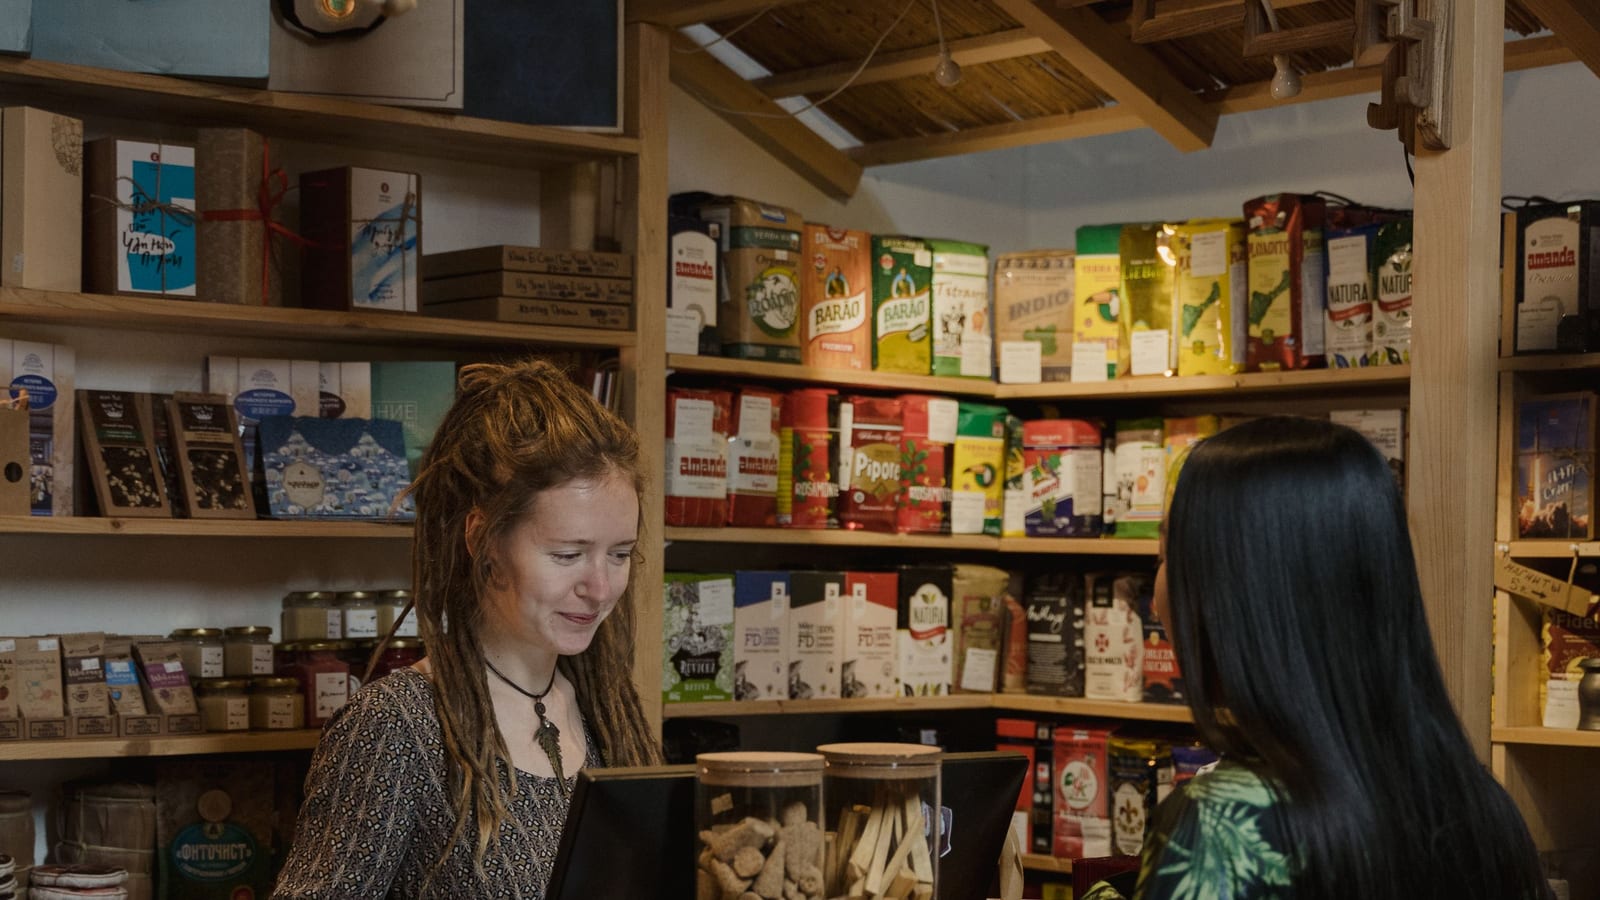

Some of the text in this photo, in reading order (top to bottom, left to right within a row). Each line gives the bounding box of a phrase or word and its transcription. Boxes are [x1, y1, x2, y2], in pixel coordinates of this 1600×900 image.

[1528, 246, 1576, 270] amanda
[676, 261, 713, 280] amanda
[1382, 274, 1413, 295] NATUR
[815, 300, 860, 325] BARÃO
[883, 299, 925, 322] BARÃO
